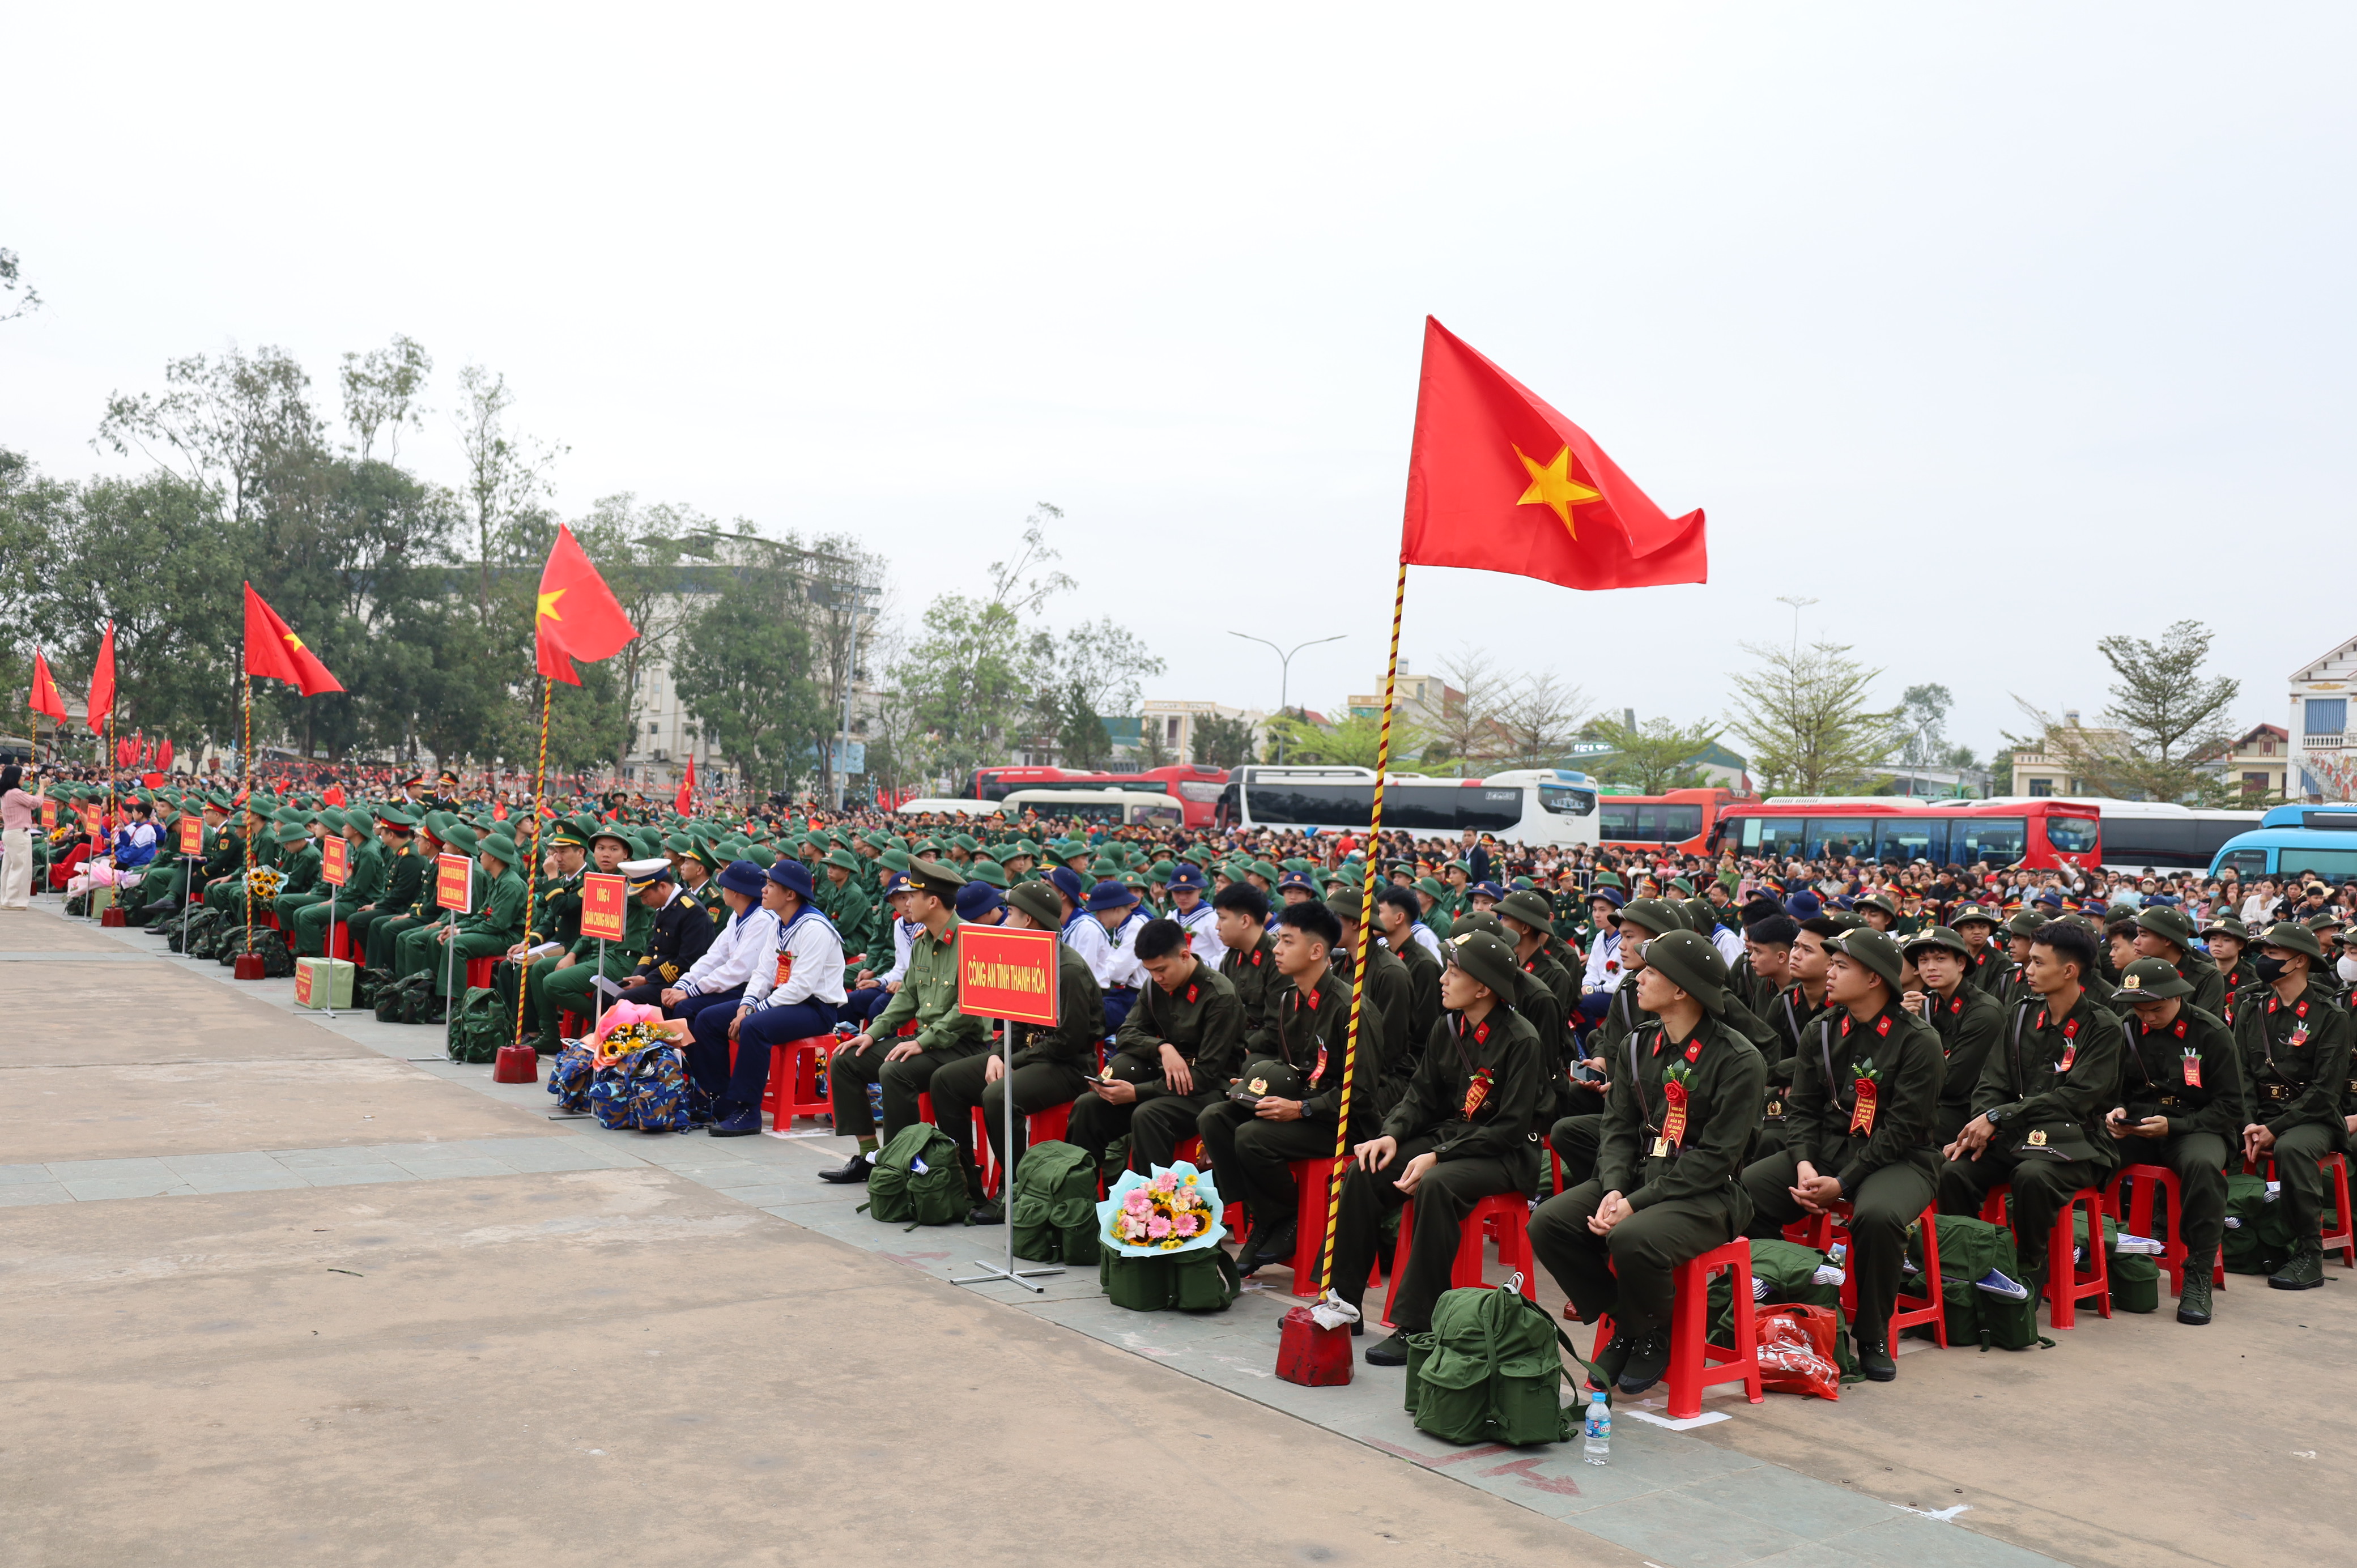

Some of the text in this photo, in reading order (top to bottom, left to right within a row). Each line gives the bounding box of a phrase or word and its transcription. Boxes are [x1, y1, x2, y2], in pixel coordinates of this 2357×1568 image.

[1733, 789, 1746, 798] VIP
[597, 884, 610, 902] VÙNG 4
[585, 907, 594, 924] QUÂN
[594, 907, 605, 927] CHỦNG
[610, 911, 619, 929] QUÂN
[968, 954, 1046, 994] CÔNG AN TỈNH THANH HÓA
